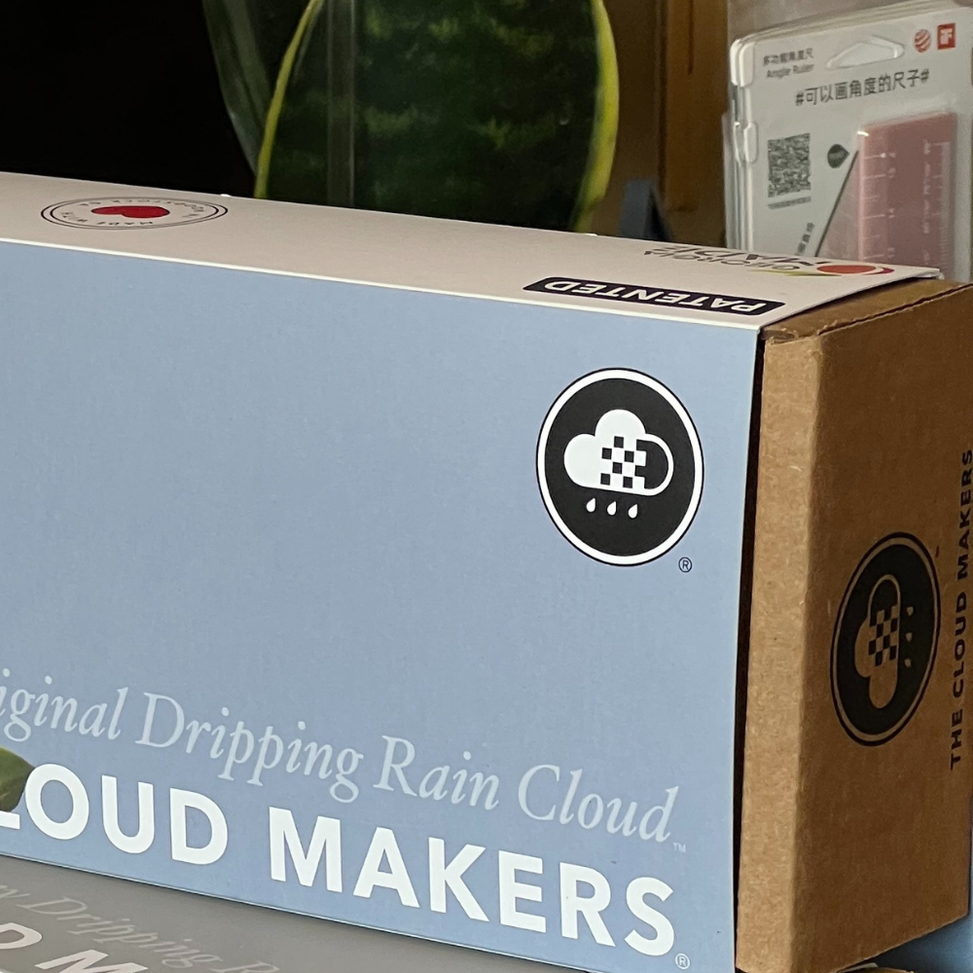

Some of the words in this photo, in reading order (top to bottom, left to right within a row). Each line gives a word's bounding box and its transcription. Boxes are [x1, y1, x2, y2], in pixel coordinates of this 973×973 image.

[544, 280, 767, 312] PATENTED
[957, 449, 973, 580] MAKERS
[953, 591, 967, 698] CLOUD
[135, 692, 364, 803] Dripping
[373, 735, 501, 809] Rain
[518, 764, 680, 842] Cloud
[950, 708, 963, 770] THE
[28, 896, 228, 973] Dripping
[269, 806, 675, 957] MAKERS
